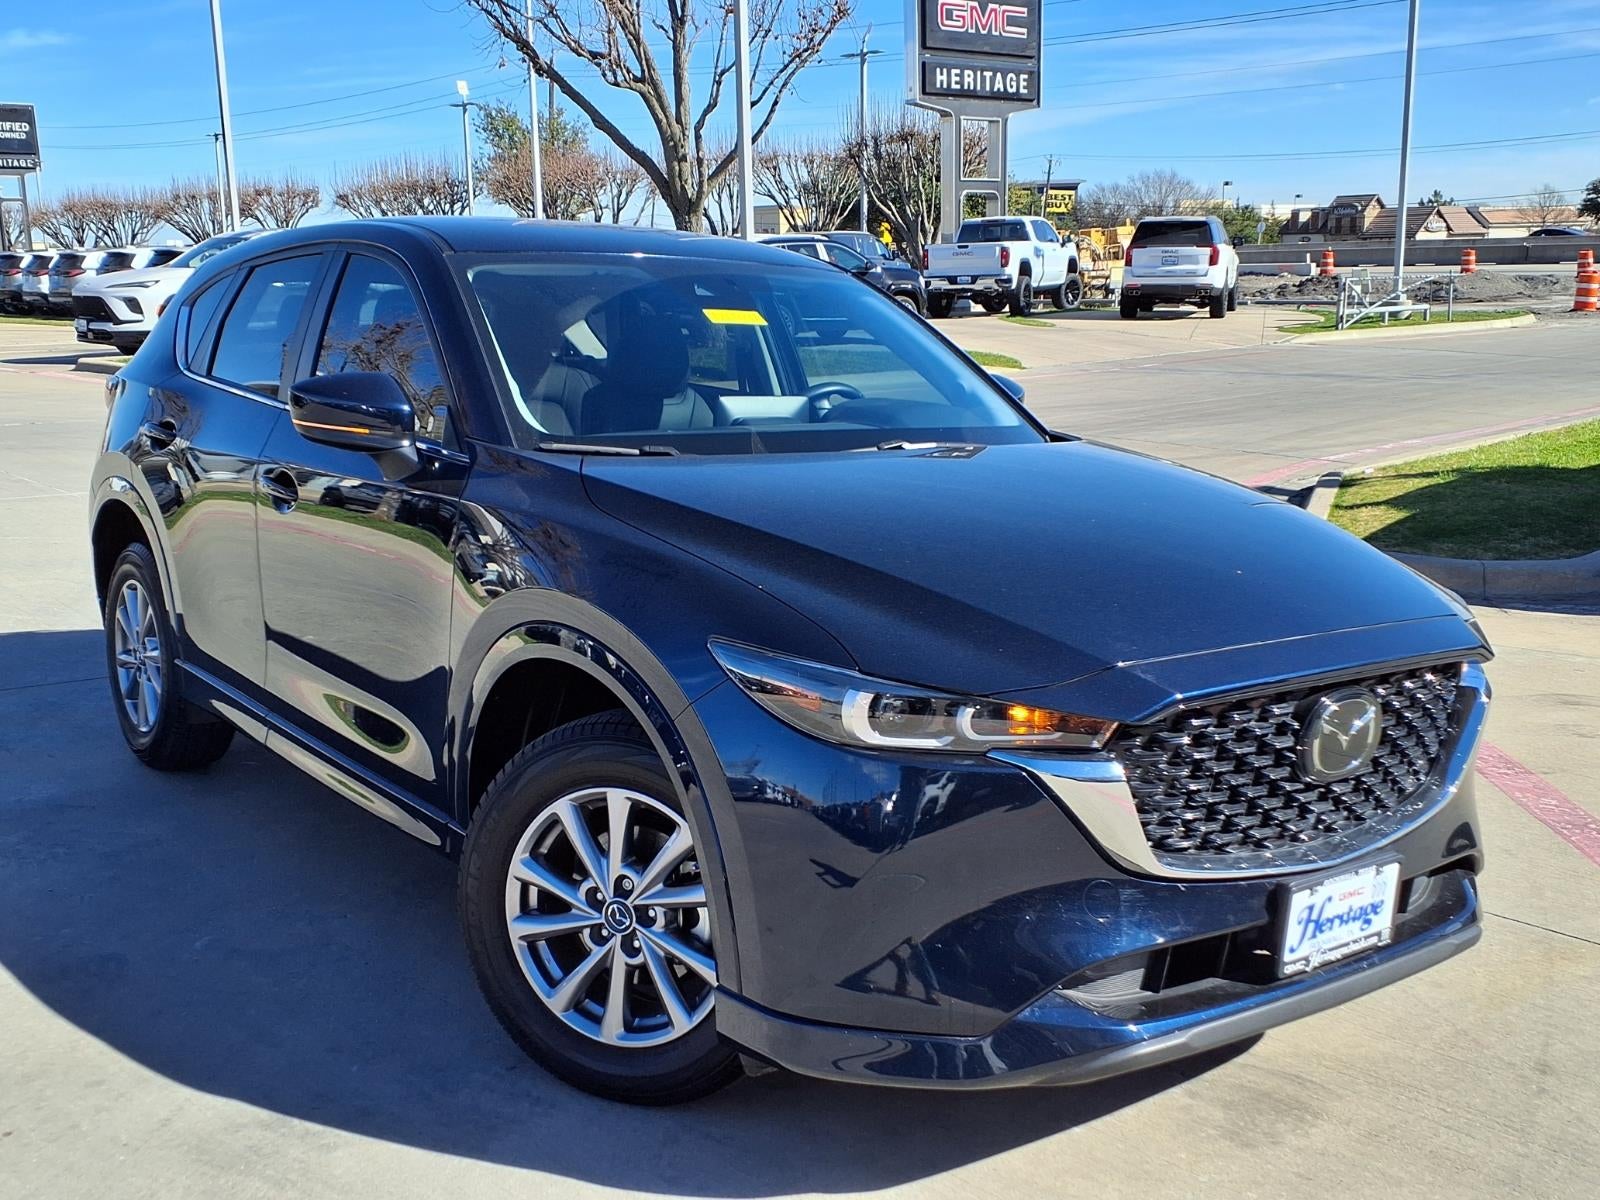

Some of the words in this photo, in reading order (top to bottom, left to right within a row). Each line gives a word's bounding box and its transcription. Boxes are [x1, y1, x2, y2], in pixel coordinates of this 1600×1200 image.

[938, 0, 1028, 38] GMC
[935, 67, 1029, 93] HERITAGE
[1046, 201, 1070, 209] BUY
[1047, 193, 1073, 201] BEST
[1288, 895, 1385, 954] Heritage
